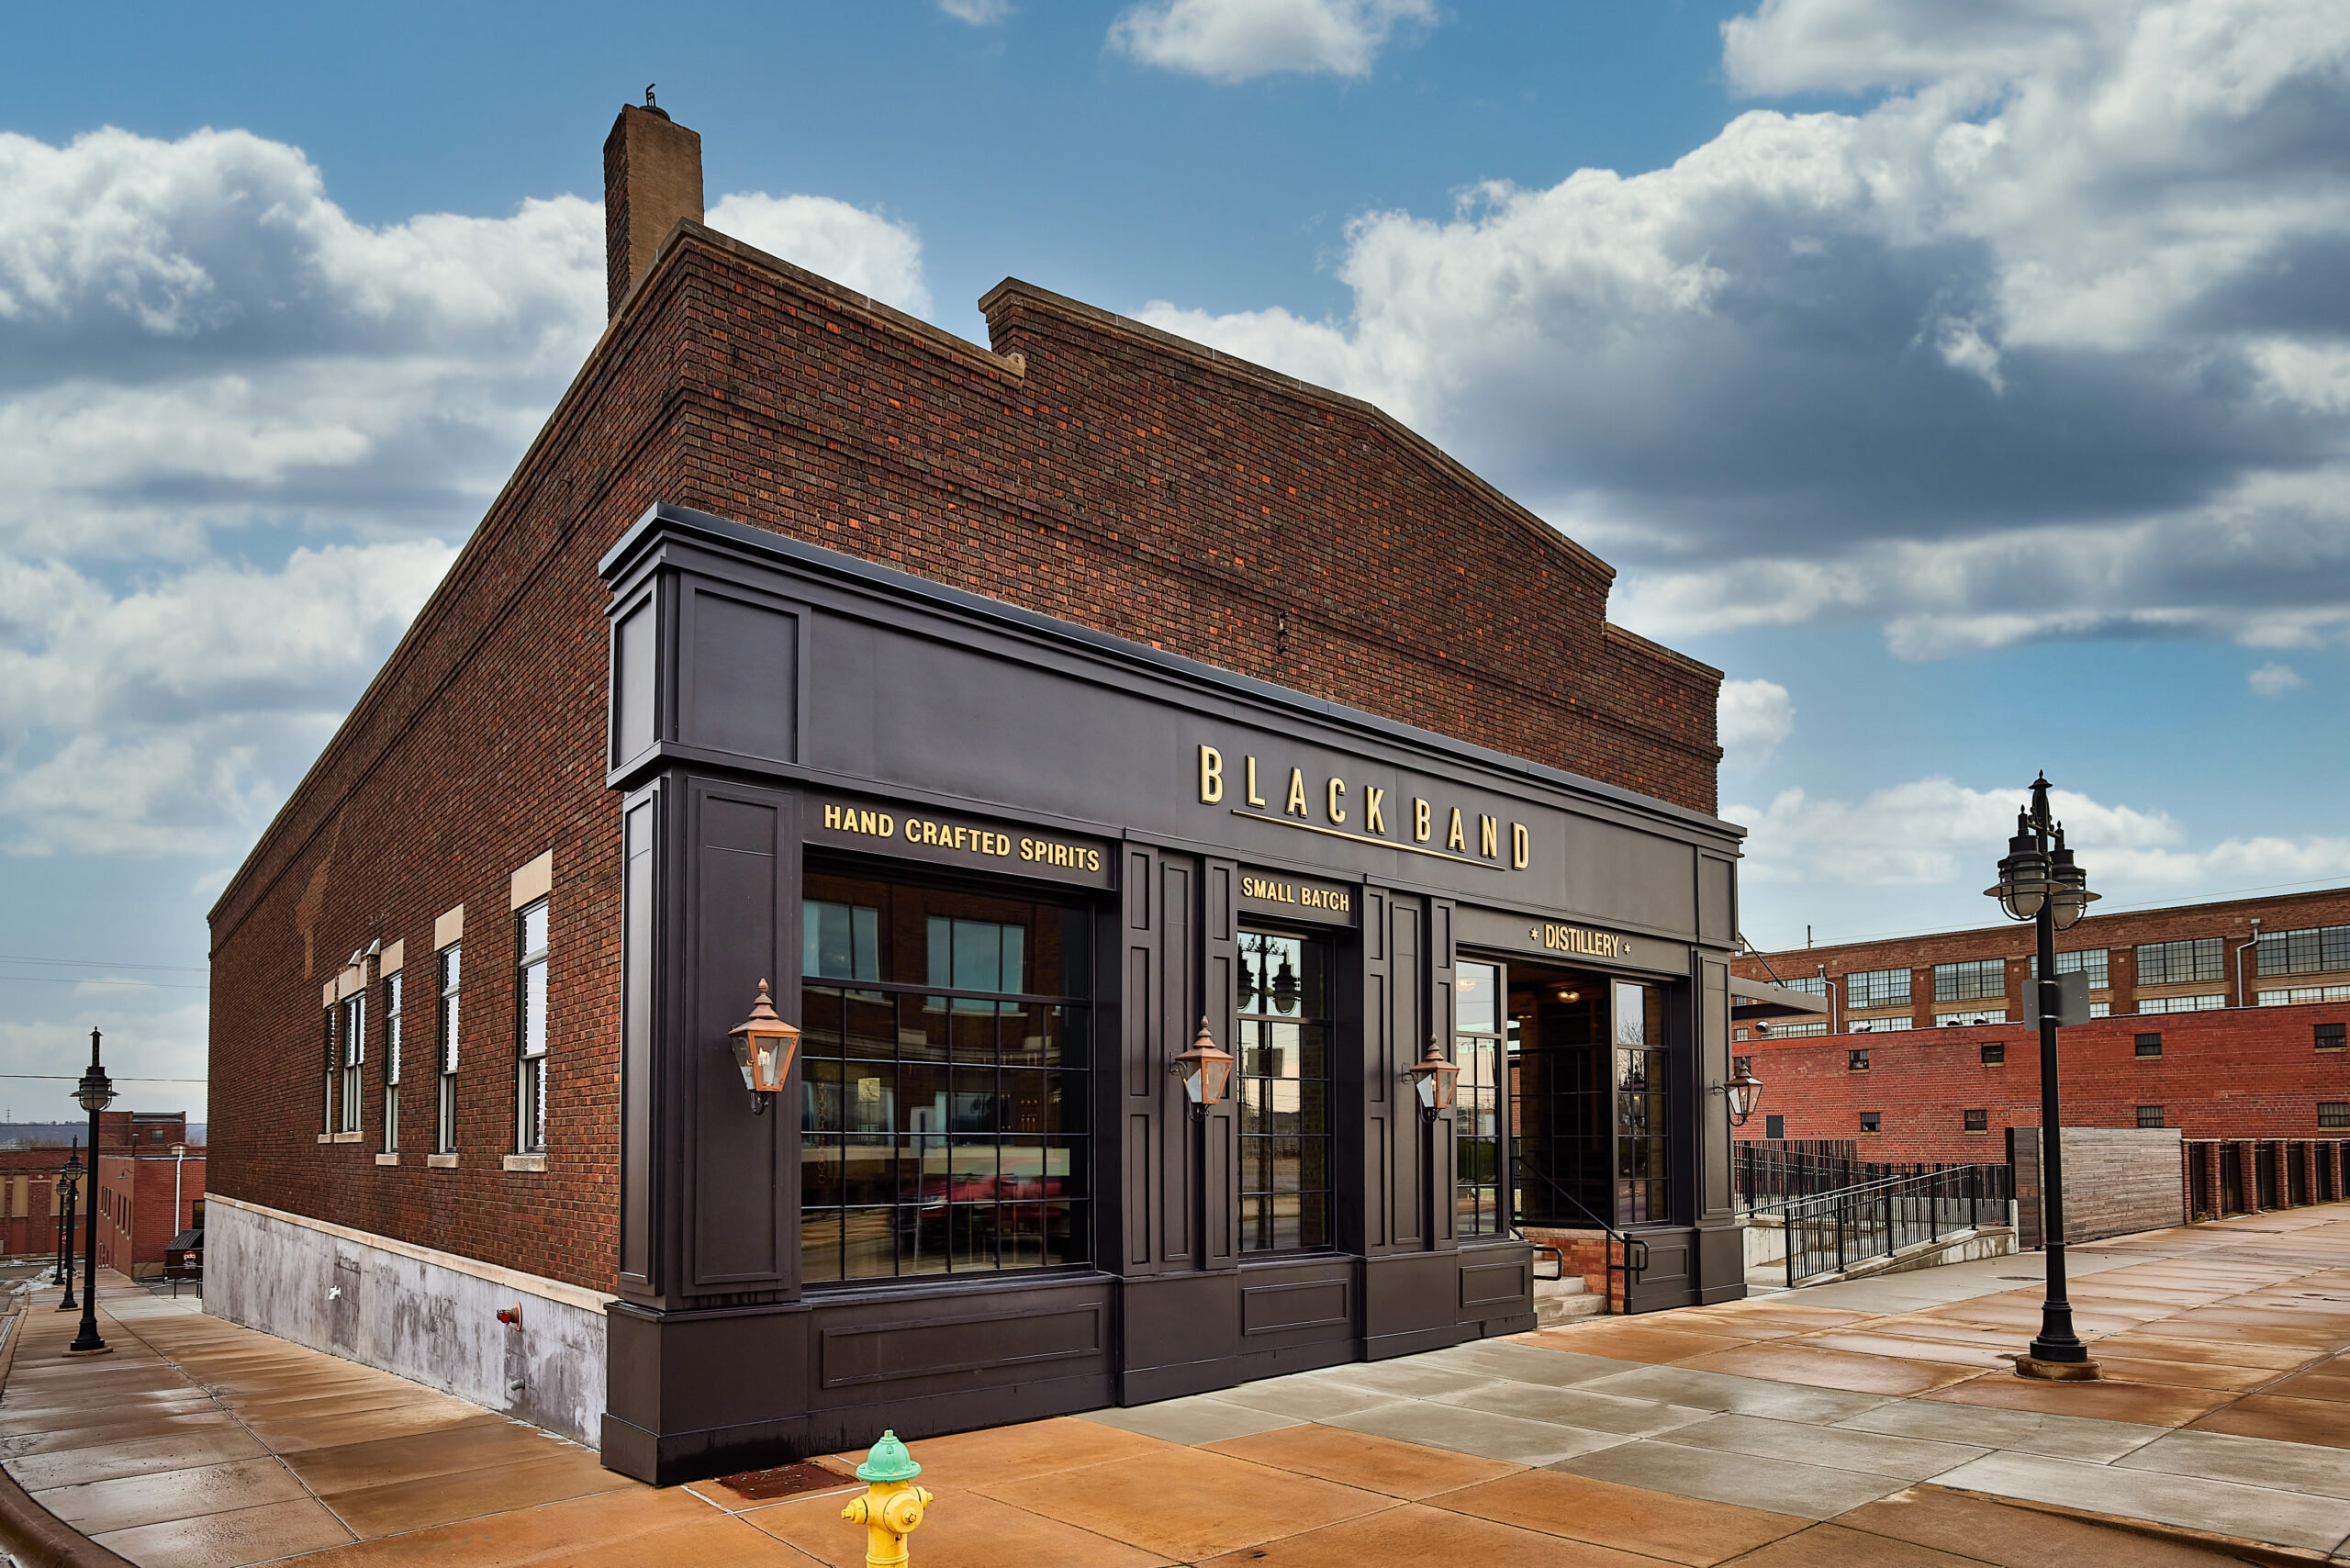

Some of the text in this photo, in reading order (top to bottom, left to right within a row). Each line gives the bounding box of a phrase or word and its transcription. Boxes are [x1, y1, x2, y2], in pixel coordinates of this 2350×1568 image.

[1199, 744, 1529, 871] BLACK BAND
[824, 804, 1100, 872] HAND CRAFTED SPIRITS
[1242, 877, 1349, 912] SMALL BATCH
[1544, 923, 1619, 958] DISTILLERY
